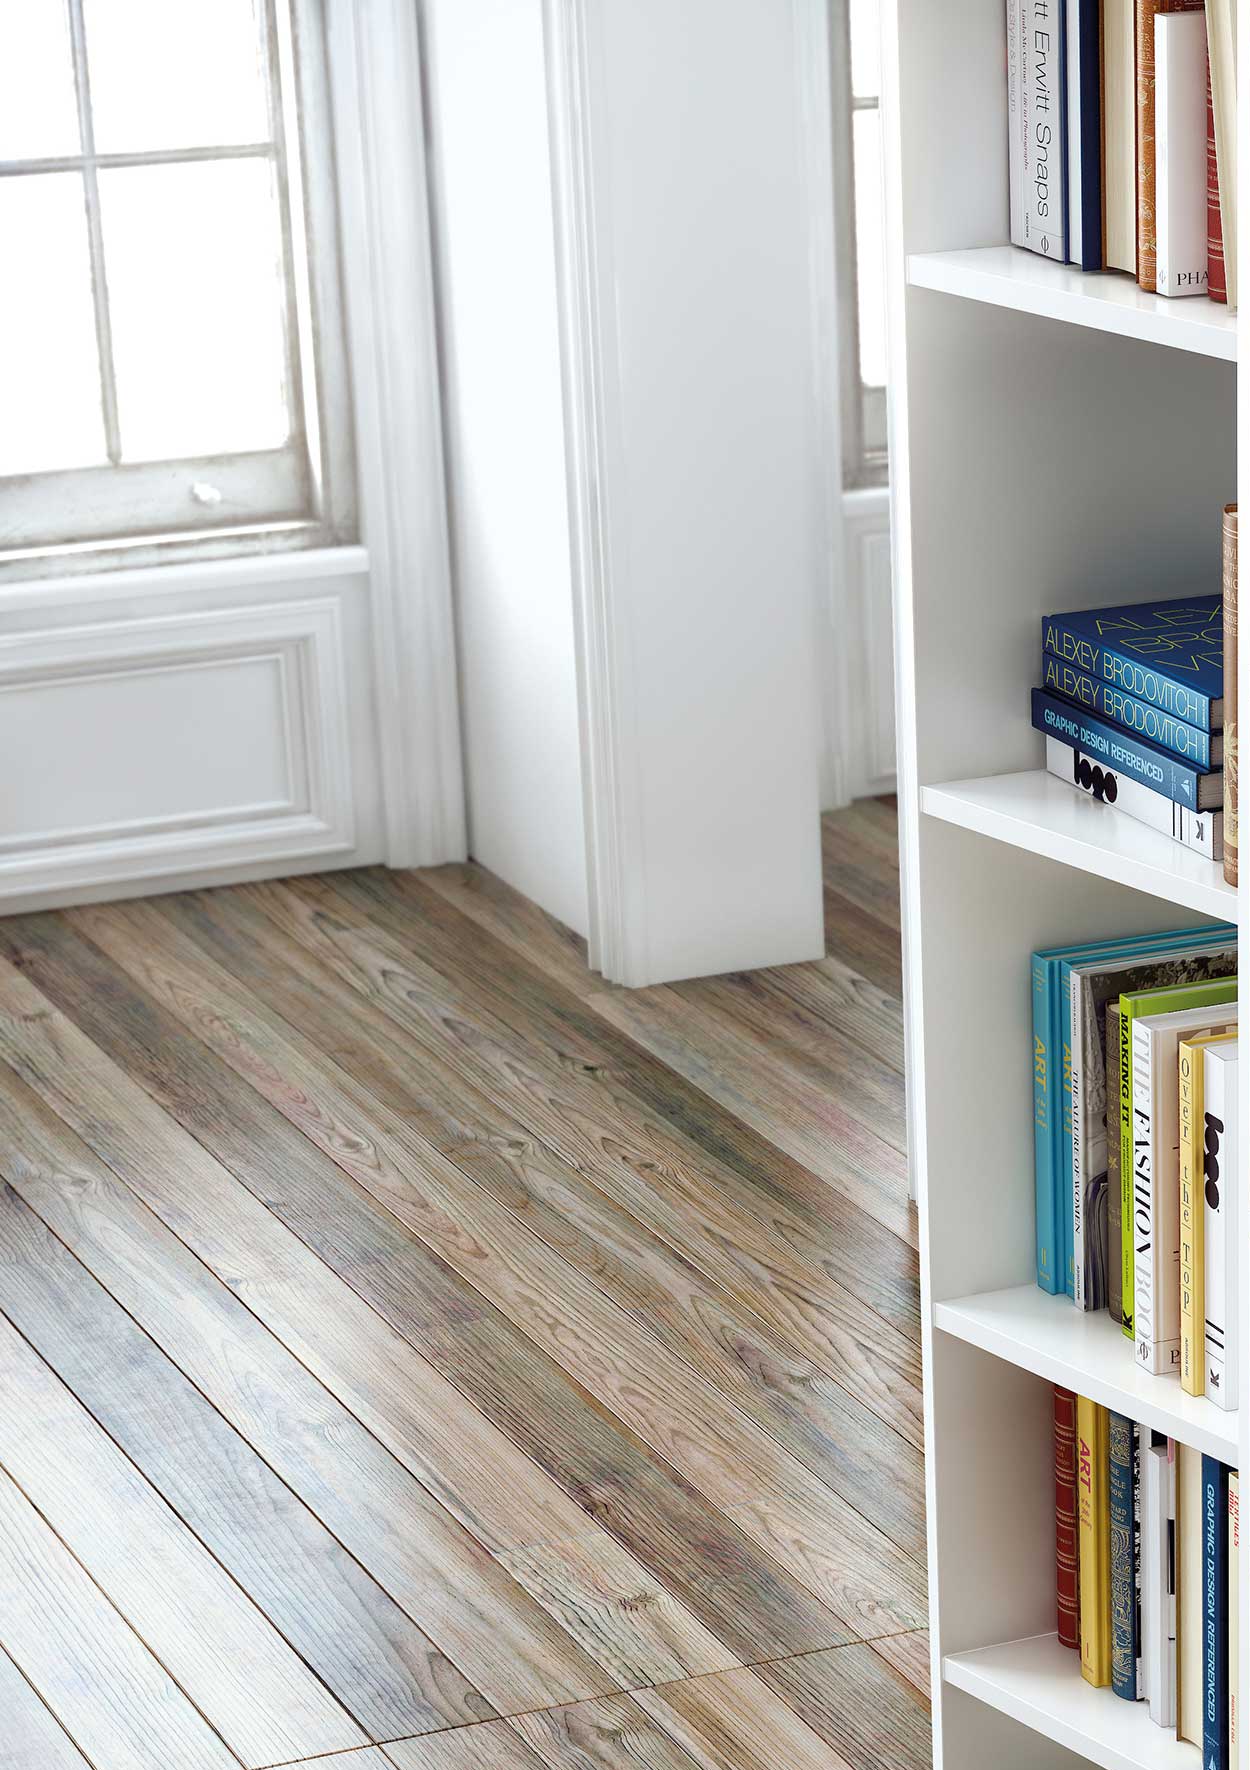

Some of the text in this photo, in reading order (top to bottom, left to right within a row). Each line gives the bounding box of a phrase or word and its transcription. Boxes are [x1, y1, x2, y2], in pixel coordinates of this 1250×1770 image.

[1034, 31, 1052, 218] Erwitt Snaps
[1045, 625, 1100, 673] ALEXEY
[1102, 652, 1198, 723] BRODOVITCH
[1045, 661, 1199, 760] ALEXEY BRODOVITCH
[1043, 708, 1164, 784] GRAPHIC DESIGN REFERENCED
[1035, 1034, 1047, 1093] ART
[1121, 1012, 1129, 1128] MAKING IT
[1073, 1096, 1081, 1156] ALLURE
[1073, 1157, 1081, 1172] OF
[1080, 1437, 1091, 1494] ART
[1205, 1482, 1216, 1723] GRAPHIC DESIGN REFERENCED
